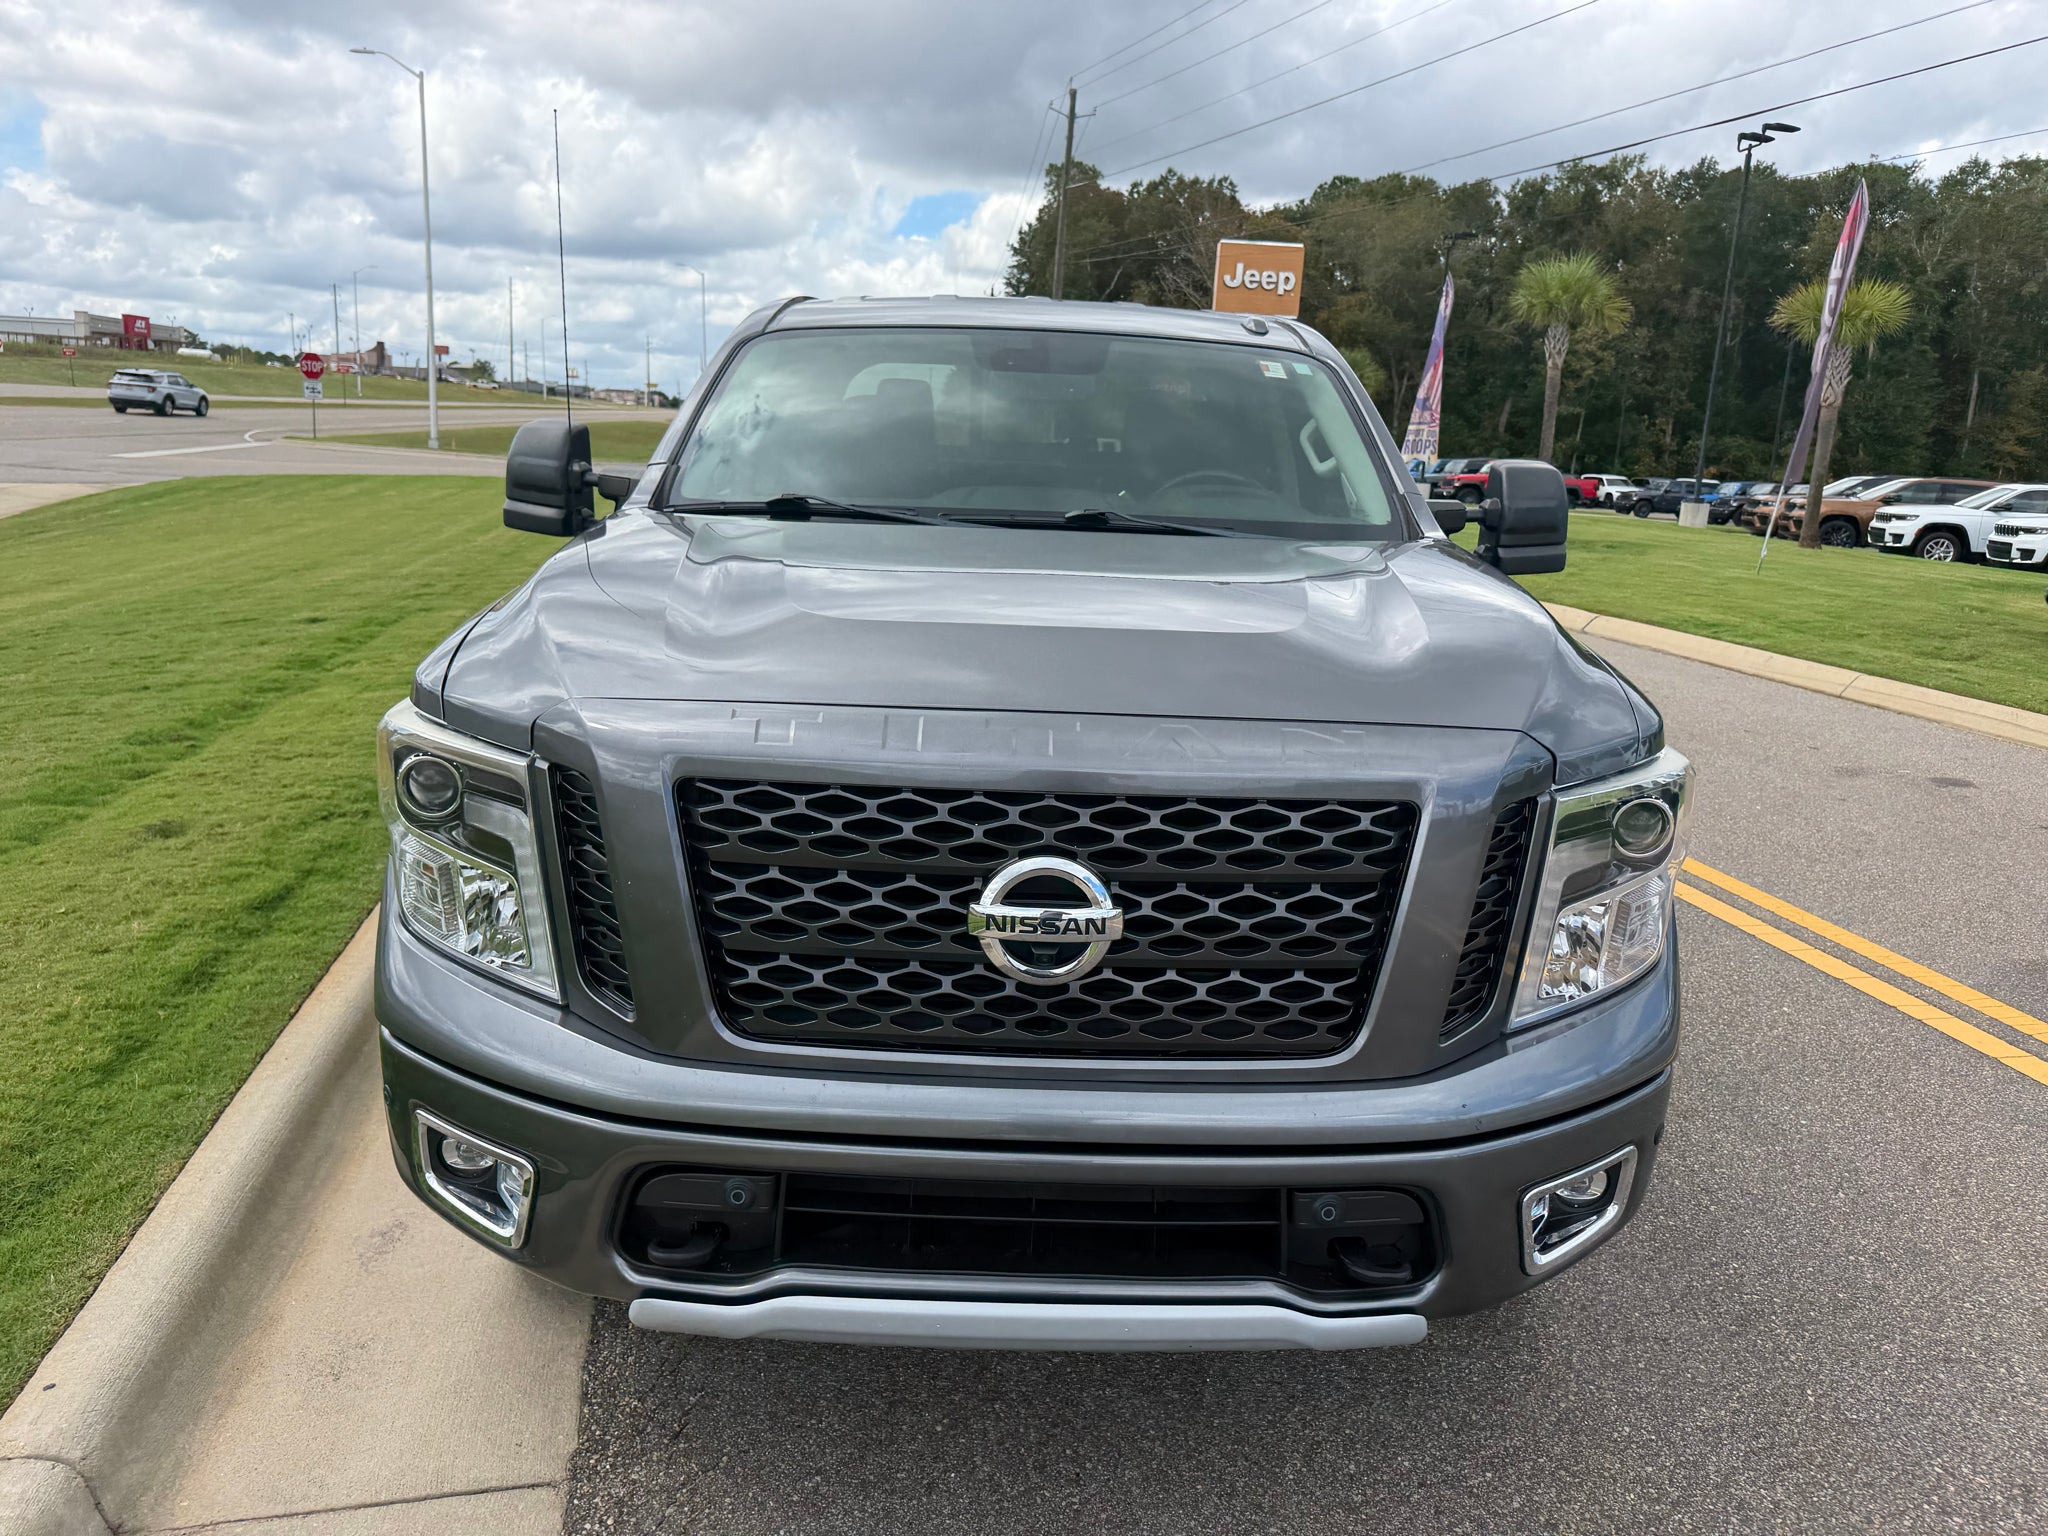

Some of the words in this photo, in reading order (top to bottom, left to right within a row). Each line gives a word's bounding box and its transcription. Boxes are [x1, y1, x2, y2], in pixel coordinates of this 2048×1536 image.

[1223, 262, 1296, 296] Jeep
[302, 360, 324, 372] STOP
[1404, 438, 1437, 455] ROOPS
[731, 707, 1366, 765] TITAN
[985, 914, 1107, 936] NISSAN
